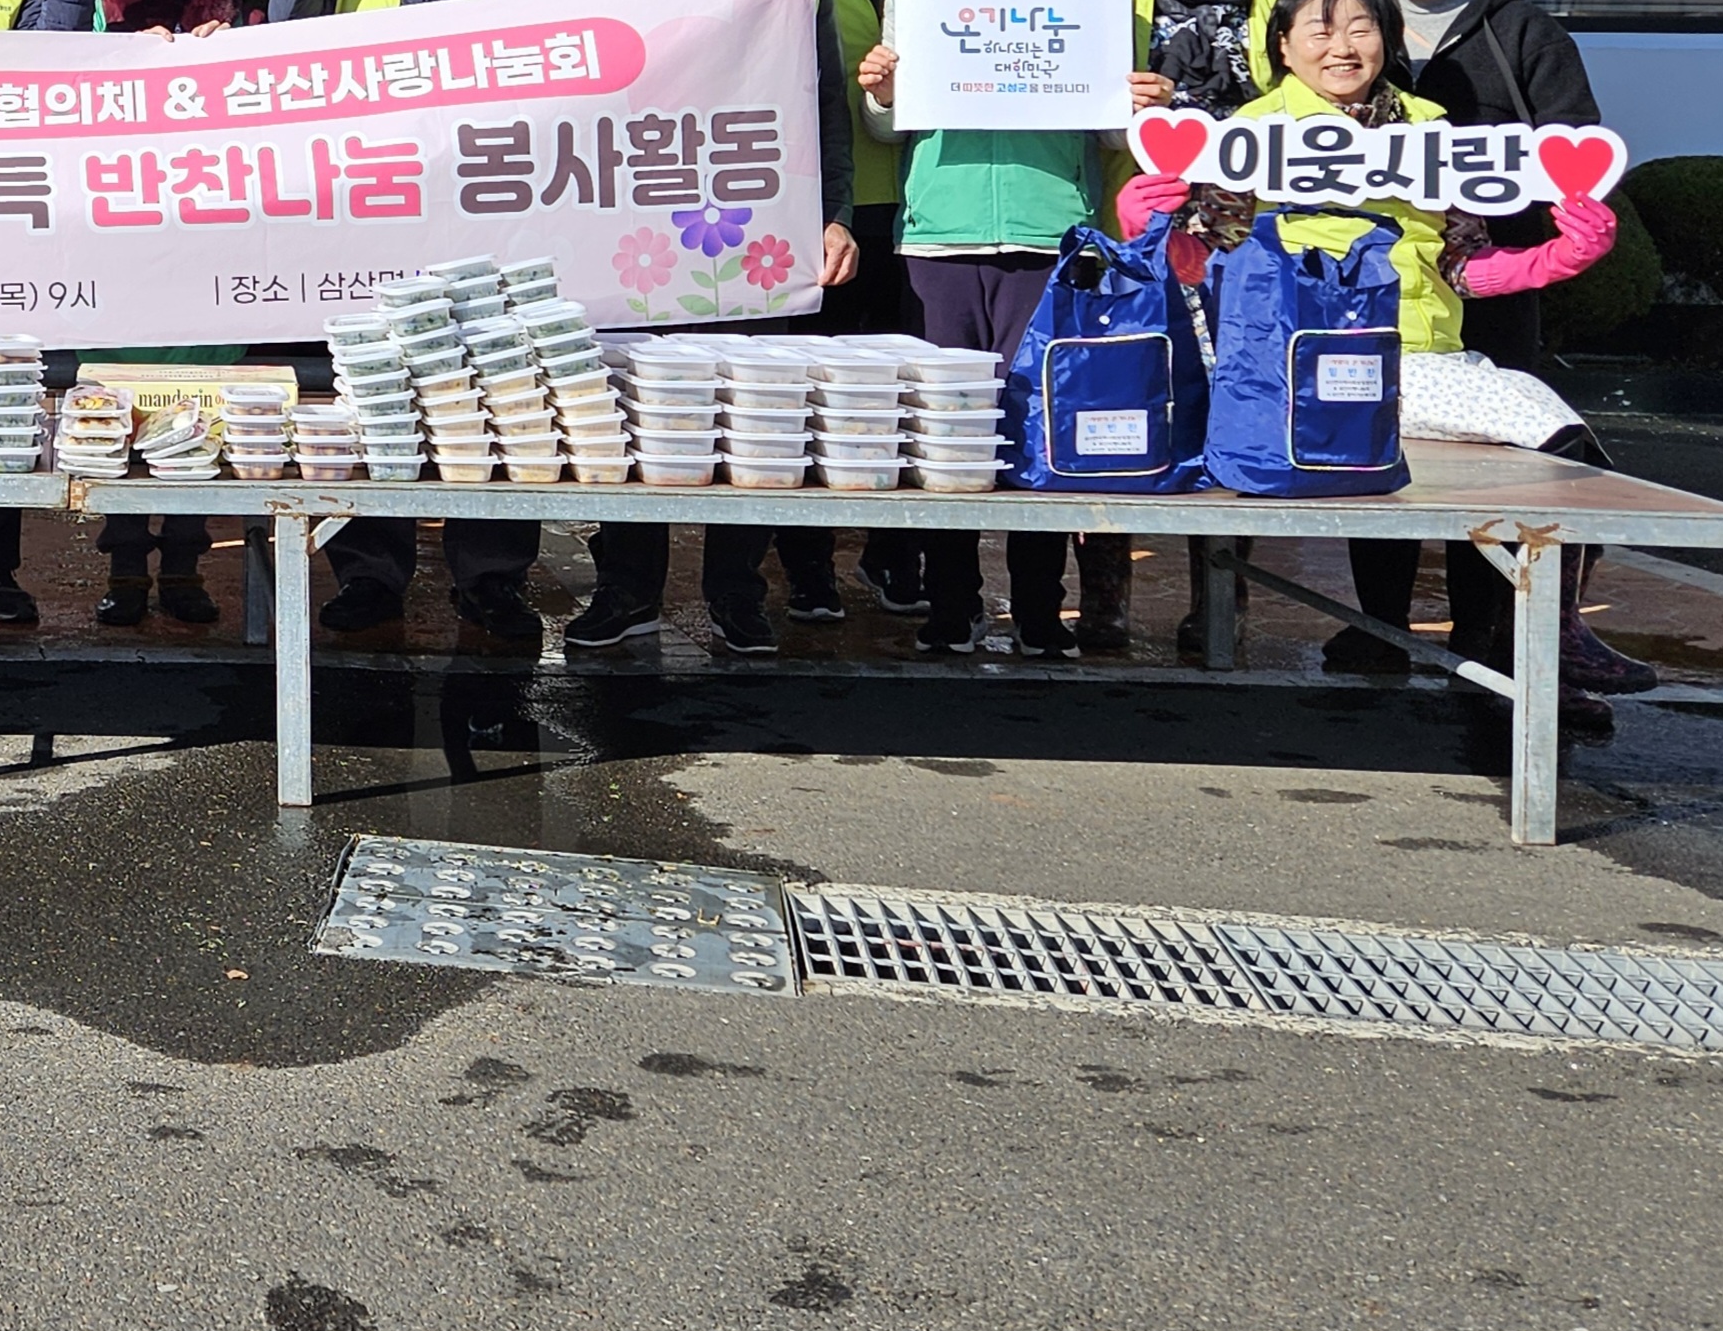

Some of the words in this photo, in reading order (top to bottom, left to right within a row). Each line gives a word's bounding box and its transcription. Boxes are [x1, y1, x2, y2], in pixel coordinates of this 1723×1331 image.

[940, 7, 1081, 54] 온기나눔
[983, 40, 1044, 59] 하나되는
[163, 80, 208, 120] &
[222, 31, 601, 116] 삼산사랑나눔회
[994, 58, 1060, 79] 대한민국
[950, 82, 961, 92] 더
[963, 82, 994, 93] 따뜻한
[996, 83, 1039, 93] 고성군을
[1043, 83, 1090, 94] 만듭니다!
[86, 135, 424, 227] 반찬나눔
[456, 108, 781, 214] 봉사활동
[1218, 125, 1531, 205] 이웃사랑
[49, 281, 97, 310] 9시
[231, 274, 290, 305] 장소
